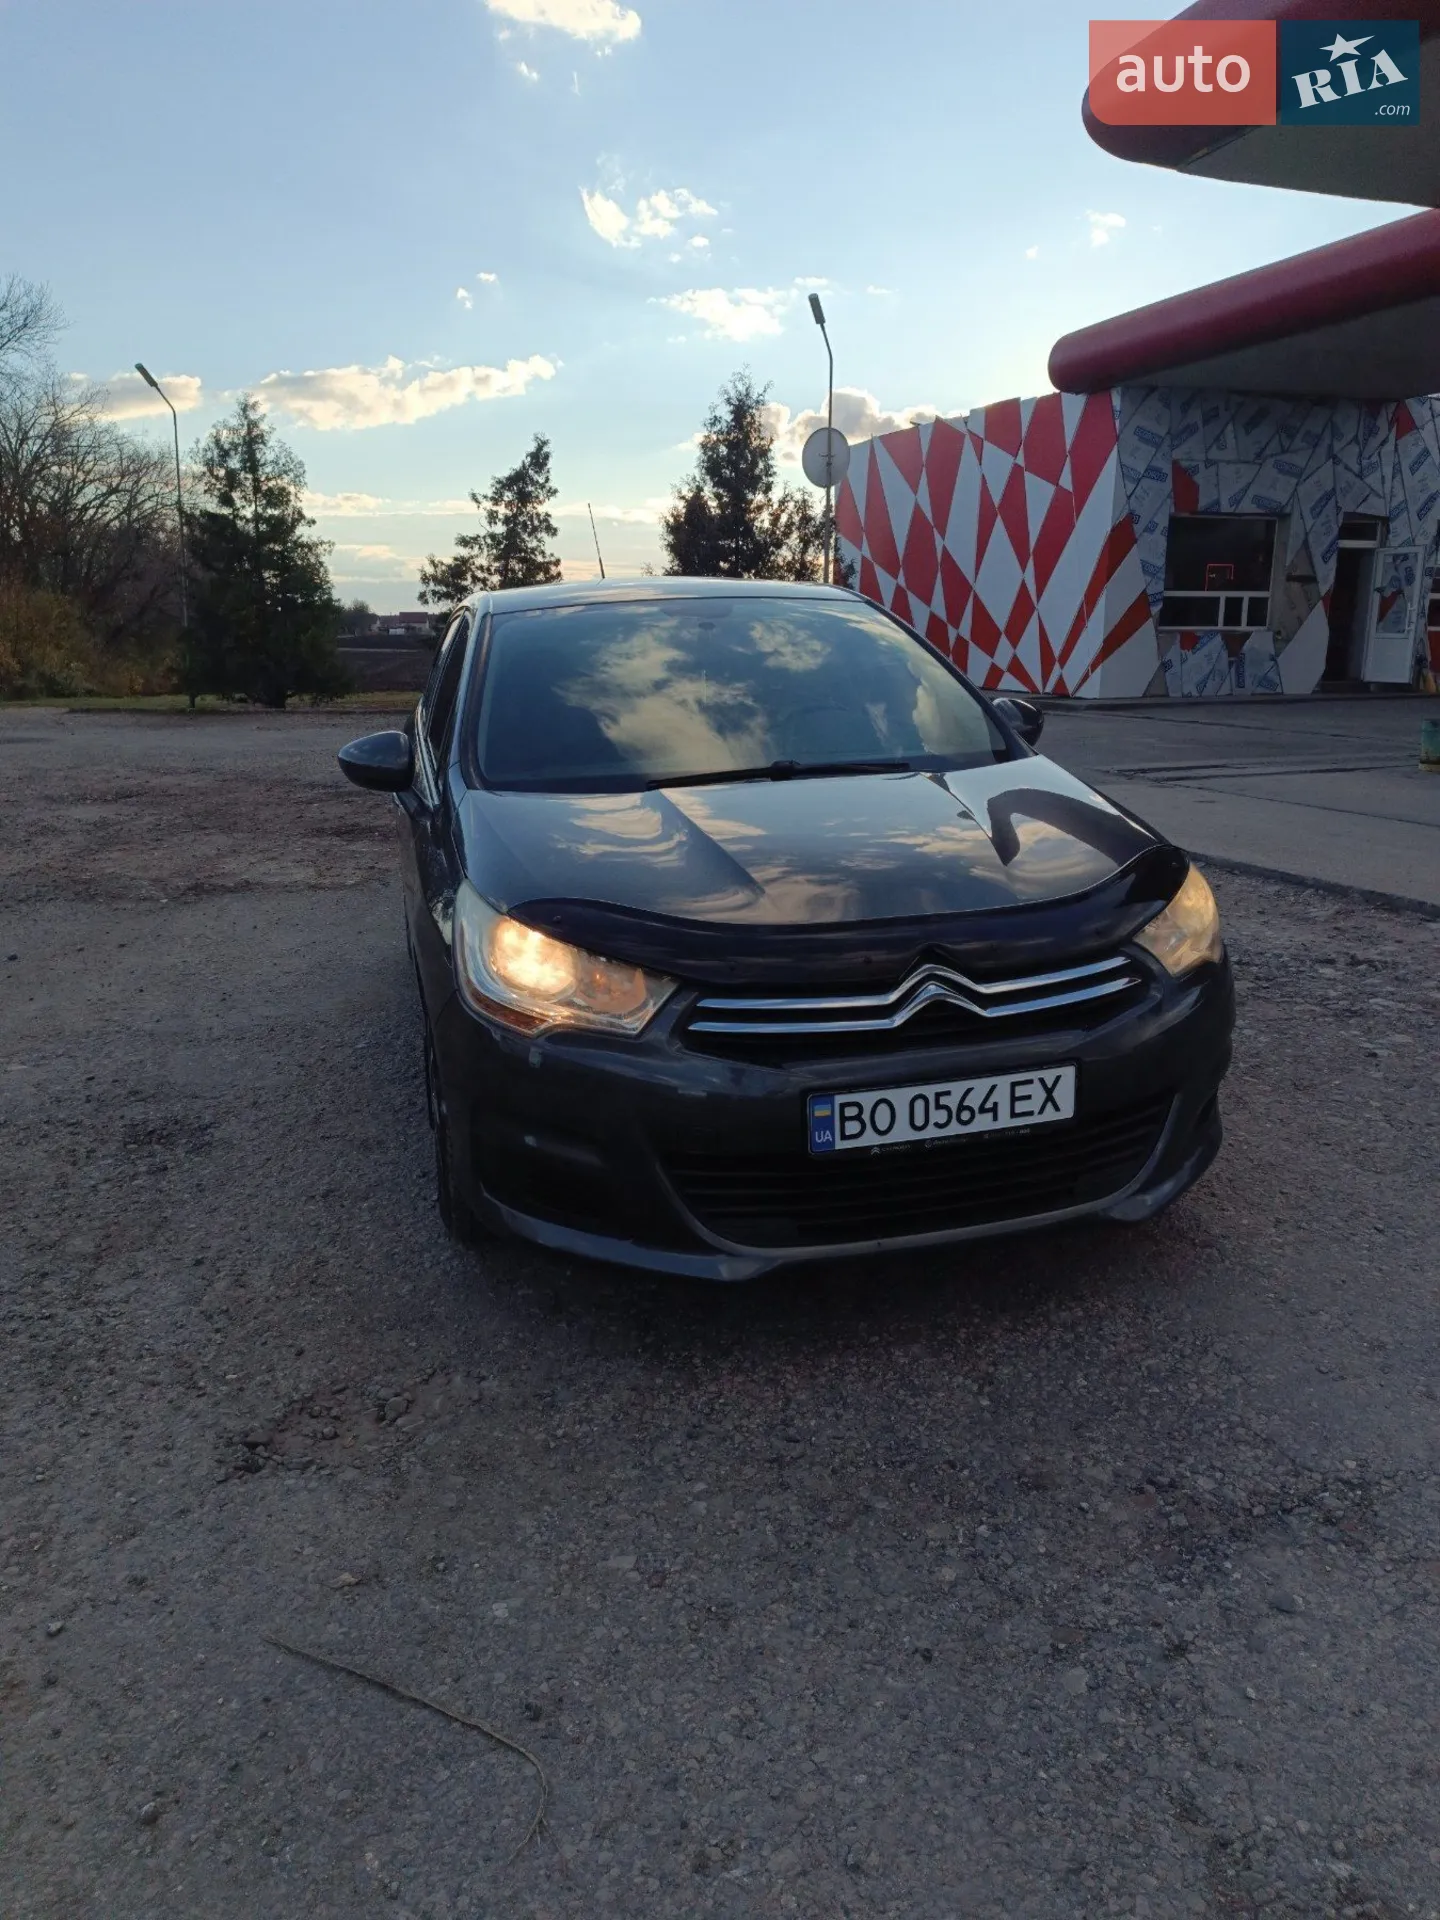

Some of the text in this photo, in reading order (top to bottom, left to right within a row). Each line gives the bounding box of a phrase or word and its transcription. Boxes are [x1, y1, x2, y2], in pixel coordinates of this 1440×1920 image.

[839, 1075, 1062, 1141] BO 0564 EX
[815, 1131, 832, 1143] UA
